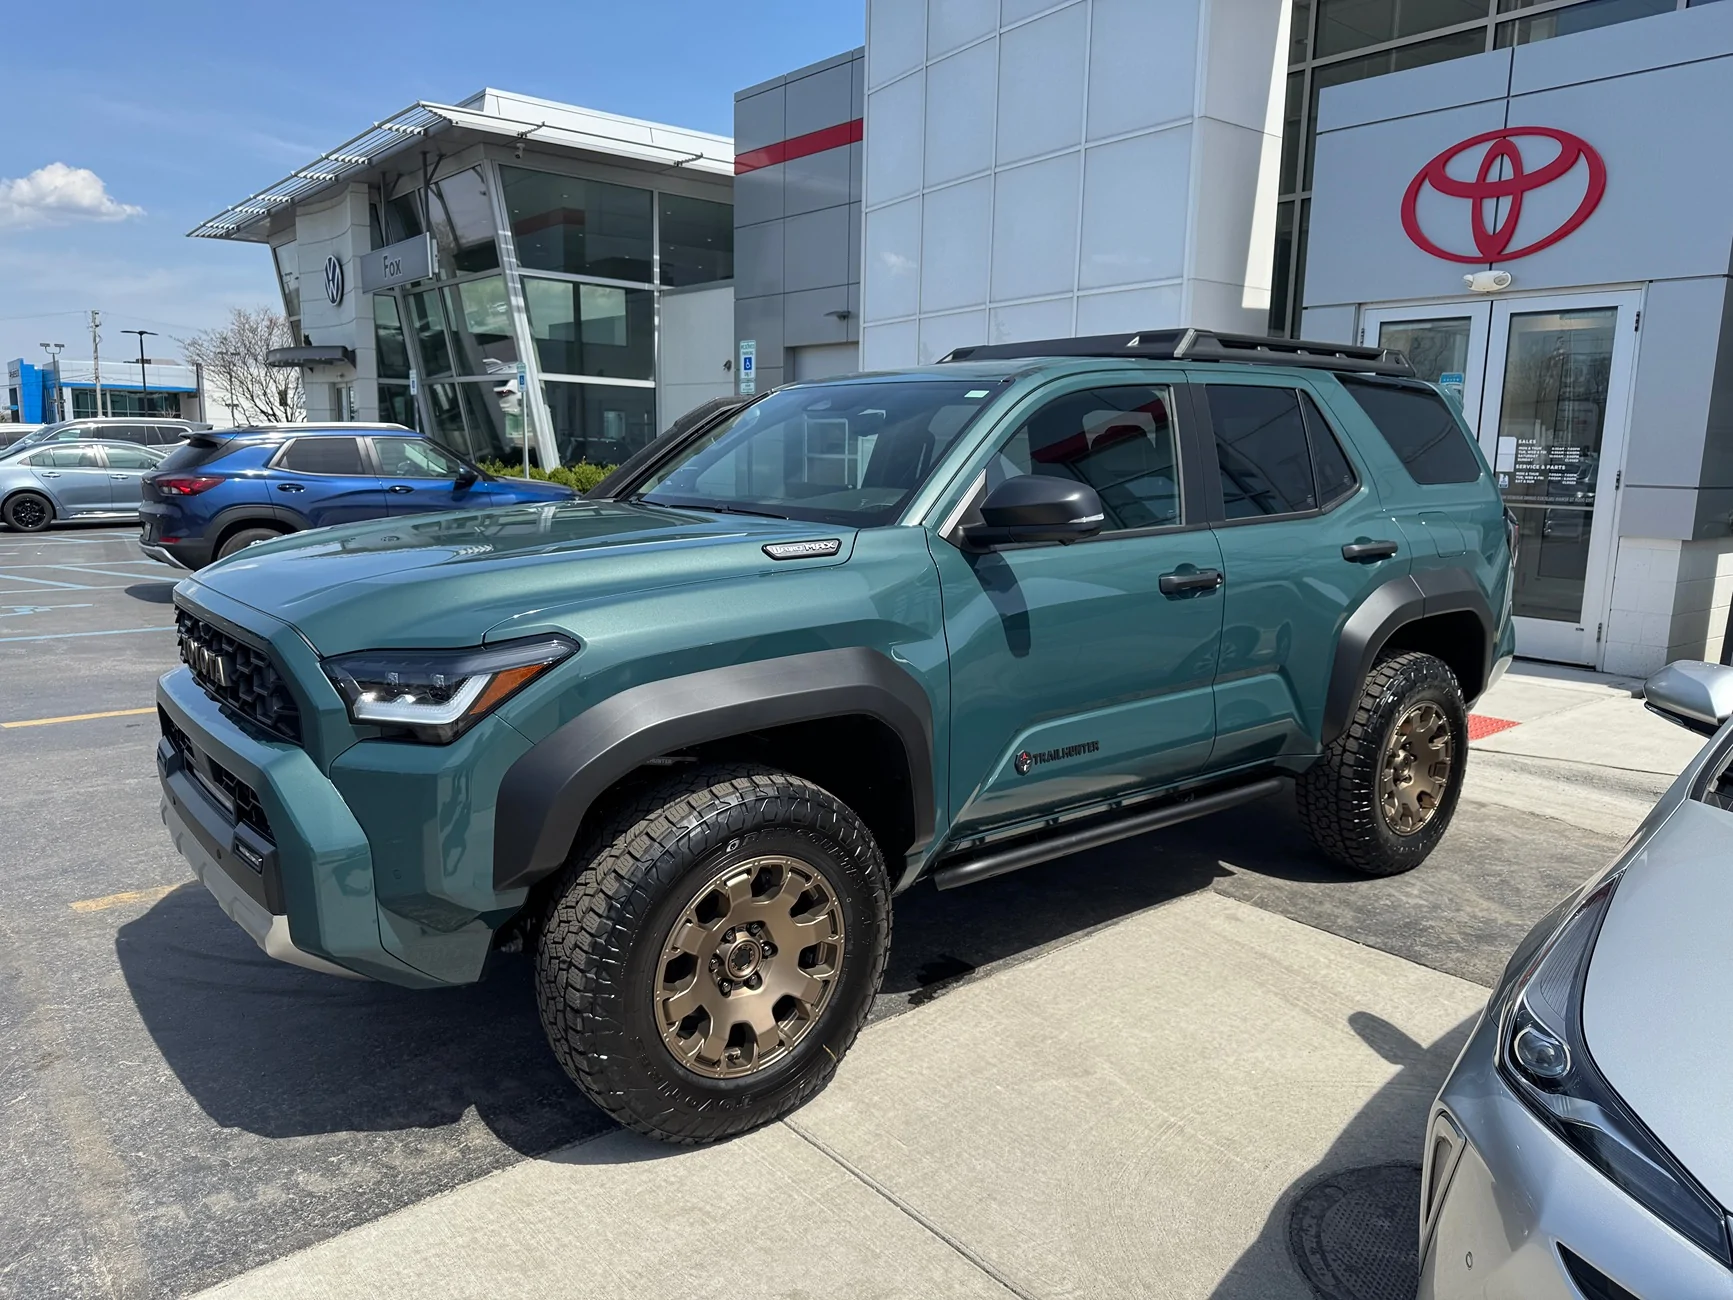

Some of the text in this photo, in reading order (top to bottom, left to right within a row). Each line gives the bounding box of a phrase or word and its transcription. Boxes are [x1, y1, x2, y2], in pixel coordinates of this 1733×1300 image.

[383, 255, 402, 278] Fox
[804, 541, 837, 552] MAX
[1032, 740, 1100, 766] TRAILHUNTER
